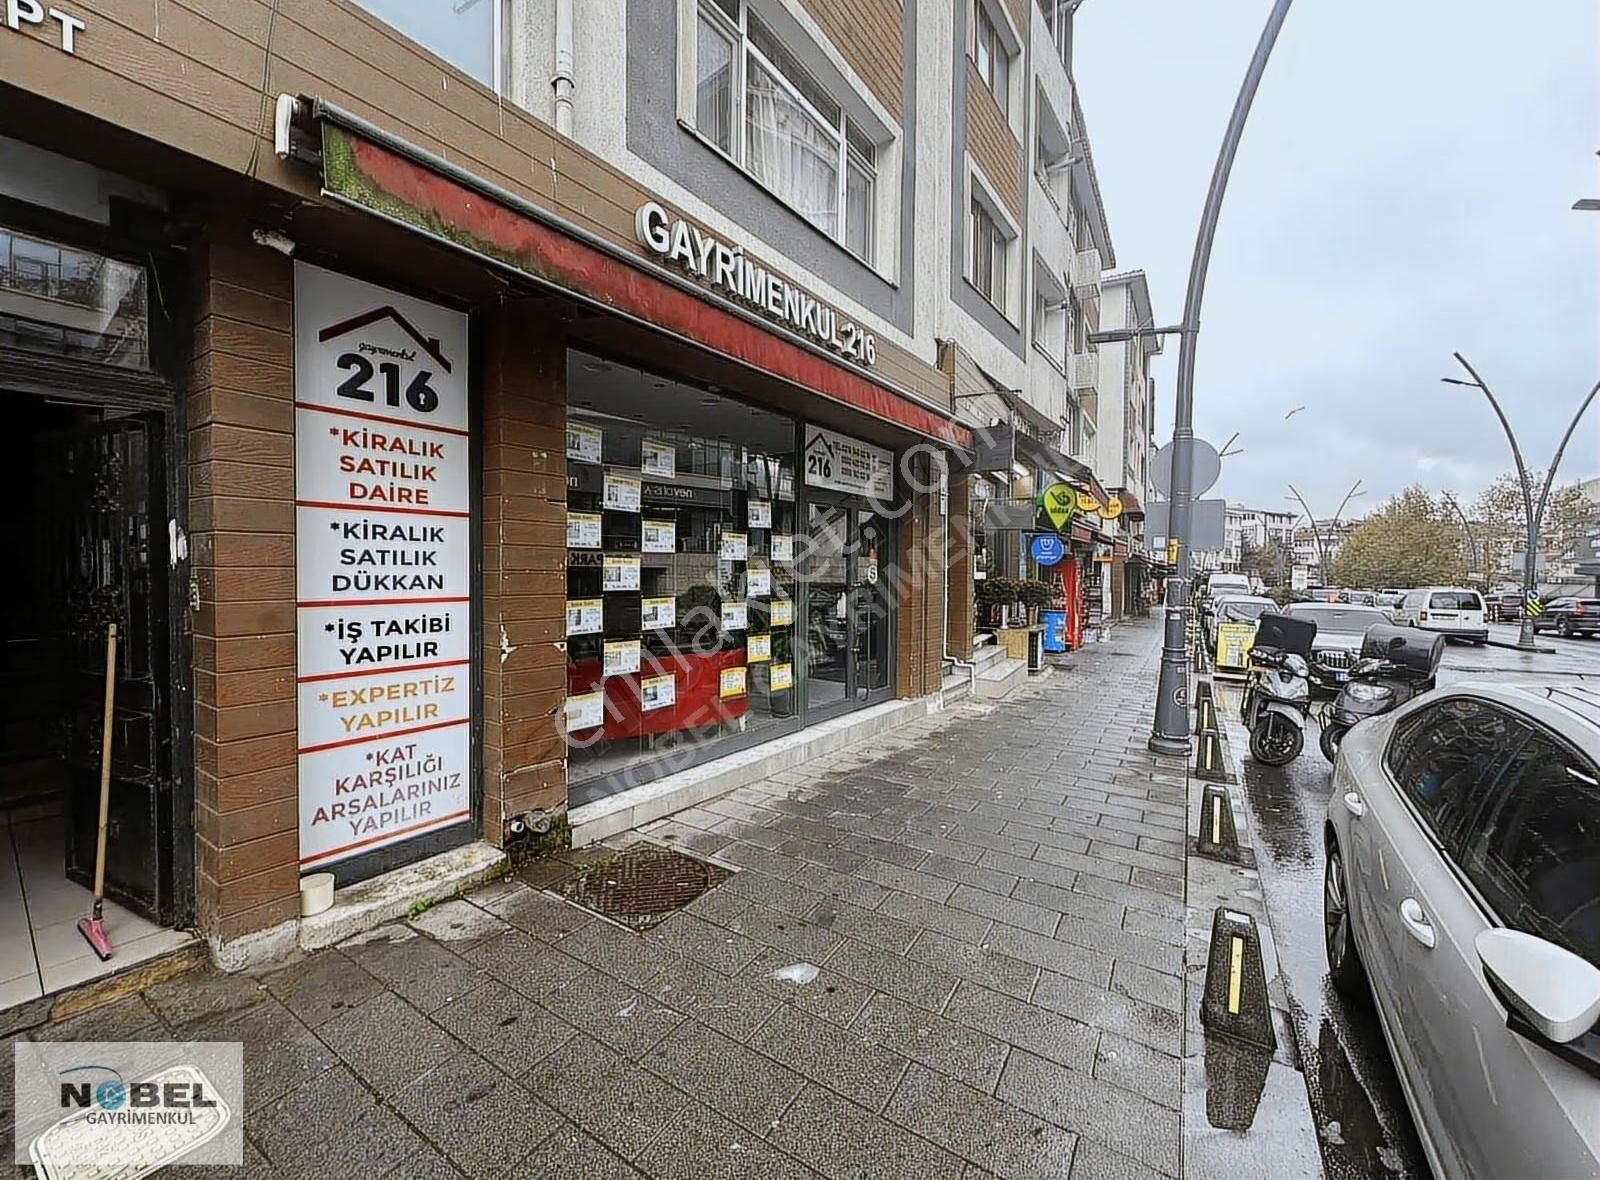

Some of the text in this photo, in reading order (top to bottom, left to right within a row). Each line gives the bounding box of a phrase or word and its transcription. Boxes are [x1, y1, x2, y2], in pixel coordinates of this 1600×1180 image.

[0, 0, 86, 54] PT
[634, 201, 877, 365] GAYRİMENKUL 216
[335, 353, 439, 413] 216
[339, 455, 437, 482] SATILIK
[807, 454, 831, 478] 216
[349, 481, 429, 505] DAİRE
[340, 548, 437, 566] SATILIK
[332, 570, 444, 592] DÜKKAN
[370, 612, 451, 637] TAKİBİ
[339, 641, 439, 665] YAPILIR
[339, 703, 439, 733] YAPILIR
[334, 753, 443, 796] KARŞILIĞI
[311, 772, 462, 826] ARSALARINIZ
[348, 801, 432, 836] YAPILIR
